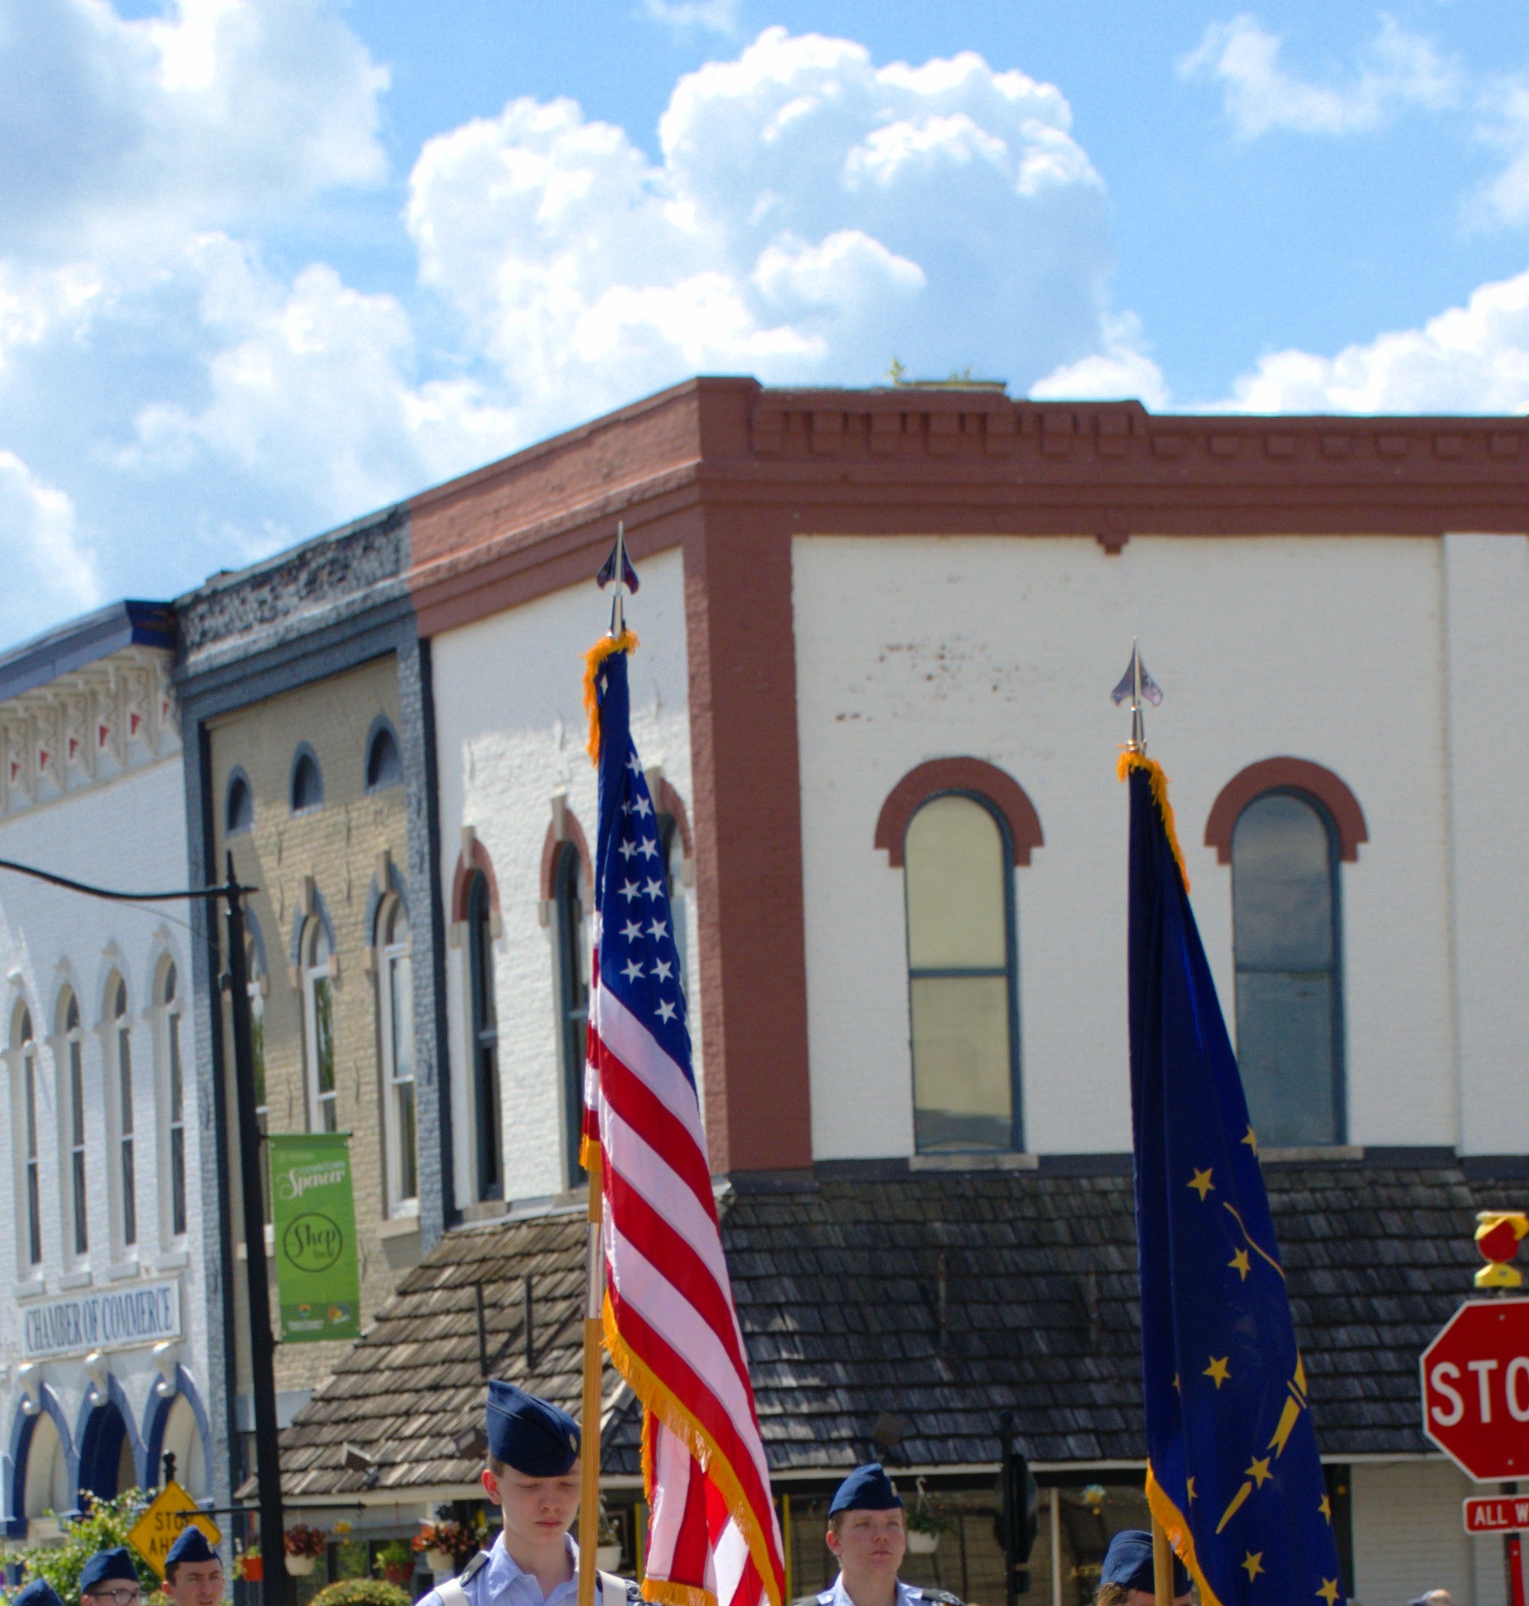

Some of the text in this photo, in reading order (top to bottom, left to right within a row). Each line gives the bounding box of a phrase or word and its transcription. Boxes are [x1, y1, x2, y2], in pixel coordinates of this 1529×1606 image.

[276, 1167, 346, 1200] Spencer
[26, 1287, 173, 1352] CHAMBER OF COMMERCE
[1473, 1504, 1509, 1527] ALL
